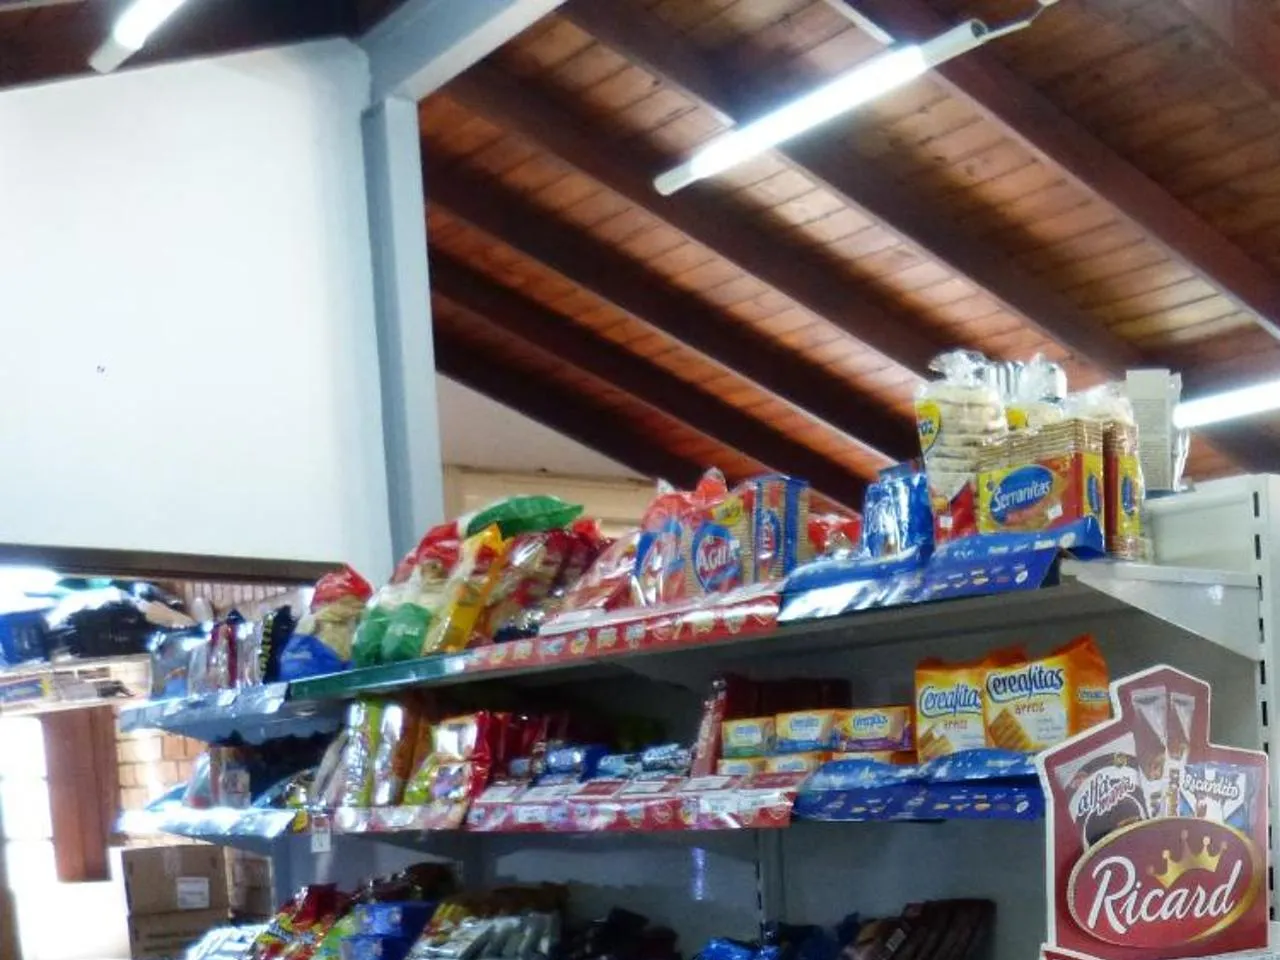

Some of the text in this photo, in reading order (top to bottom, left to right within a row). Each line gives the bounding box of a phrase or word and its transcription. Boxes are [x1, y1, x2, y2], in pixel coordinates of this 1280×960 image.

[991, 480, 1051, 512] Serranitas
[919, 684, 982, 717] Cerealita
[986, 664, 1064, 703] Cerealitas
[1087, 855, 1243, 935] Ricard
